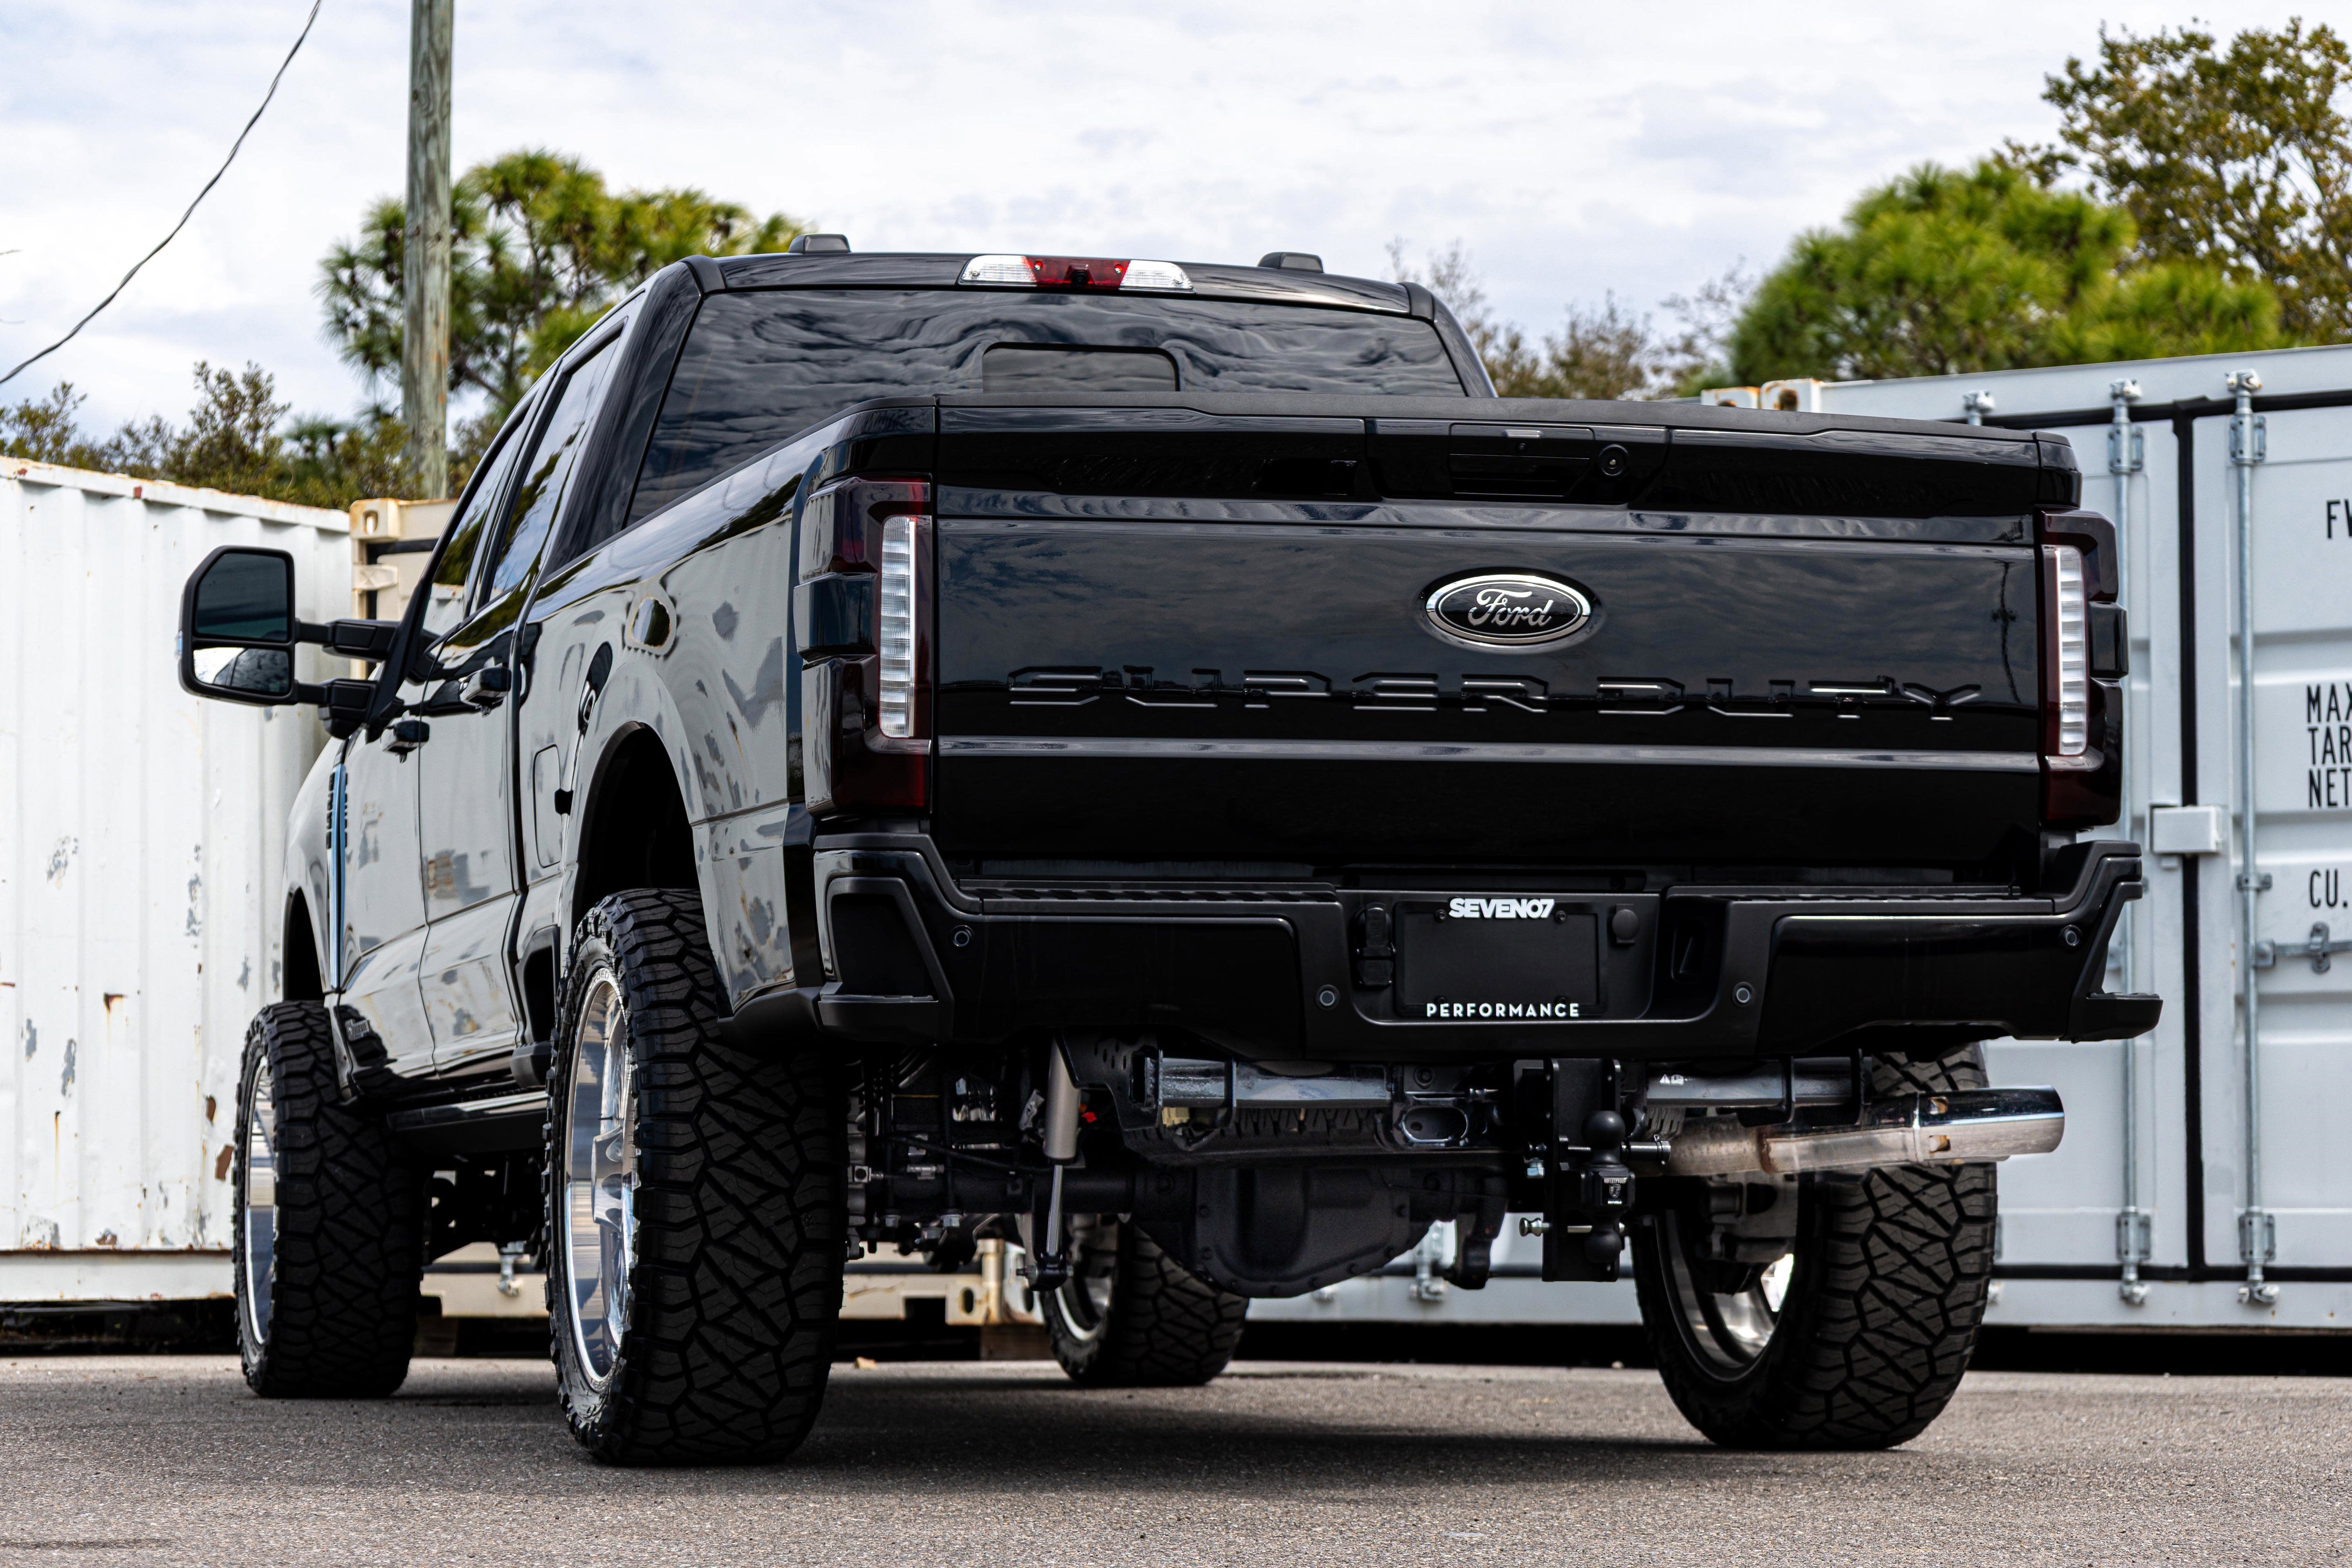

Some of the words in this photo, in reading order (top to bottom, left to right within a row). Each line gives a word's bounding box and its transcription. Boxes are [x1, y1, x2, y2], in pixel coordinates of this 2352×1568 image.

[1468, 588, 1554, 626] Ford
[1007, 665, 1550, 714] SUPER
[1596, 676, 1982, 722] DUTY
[2309, 767, 2351, 808] NET
[1427, 1003, 1580, 1017] PERFORMANCE
